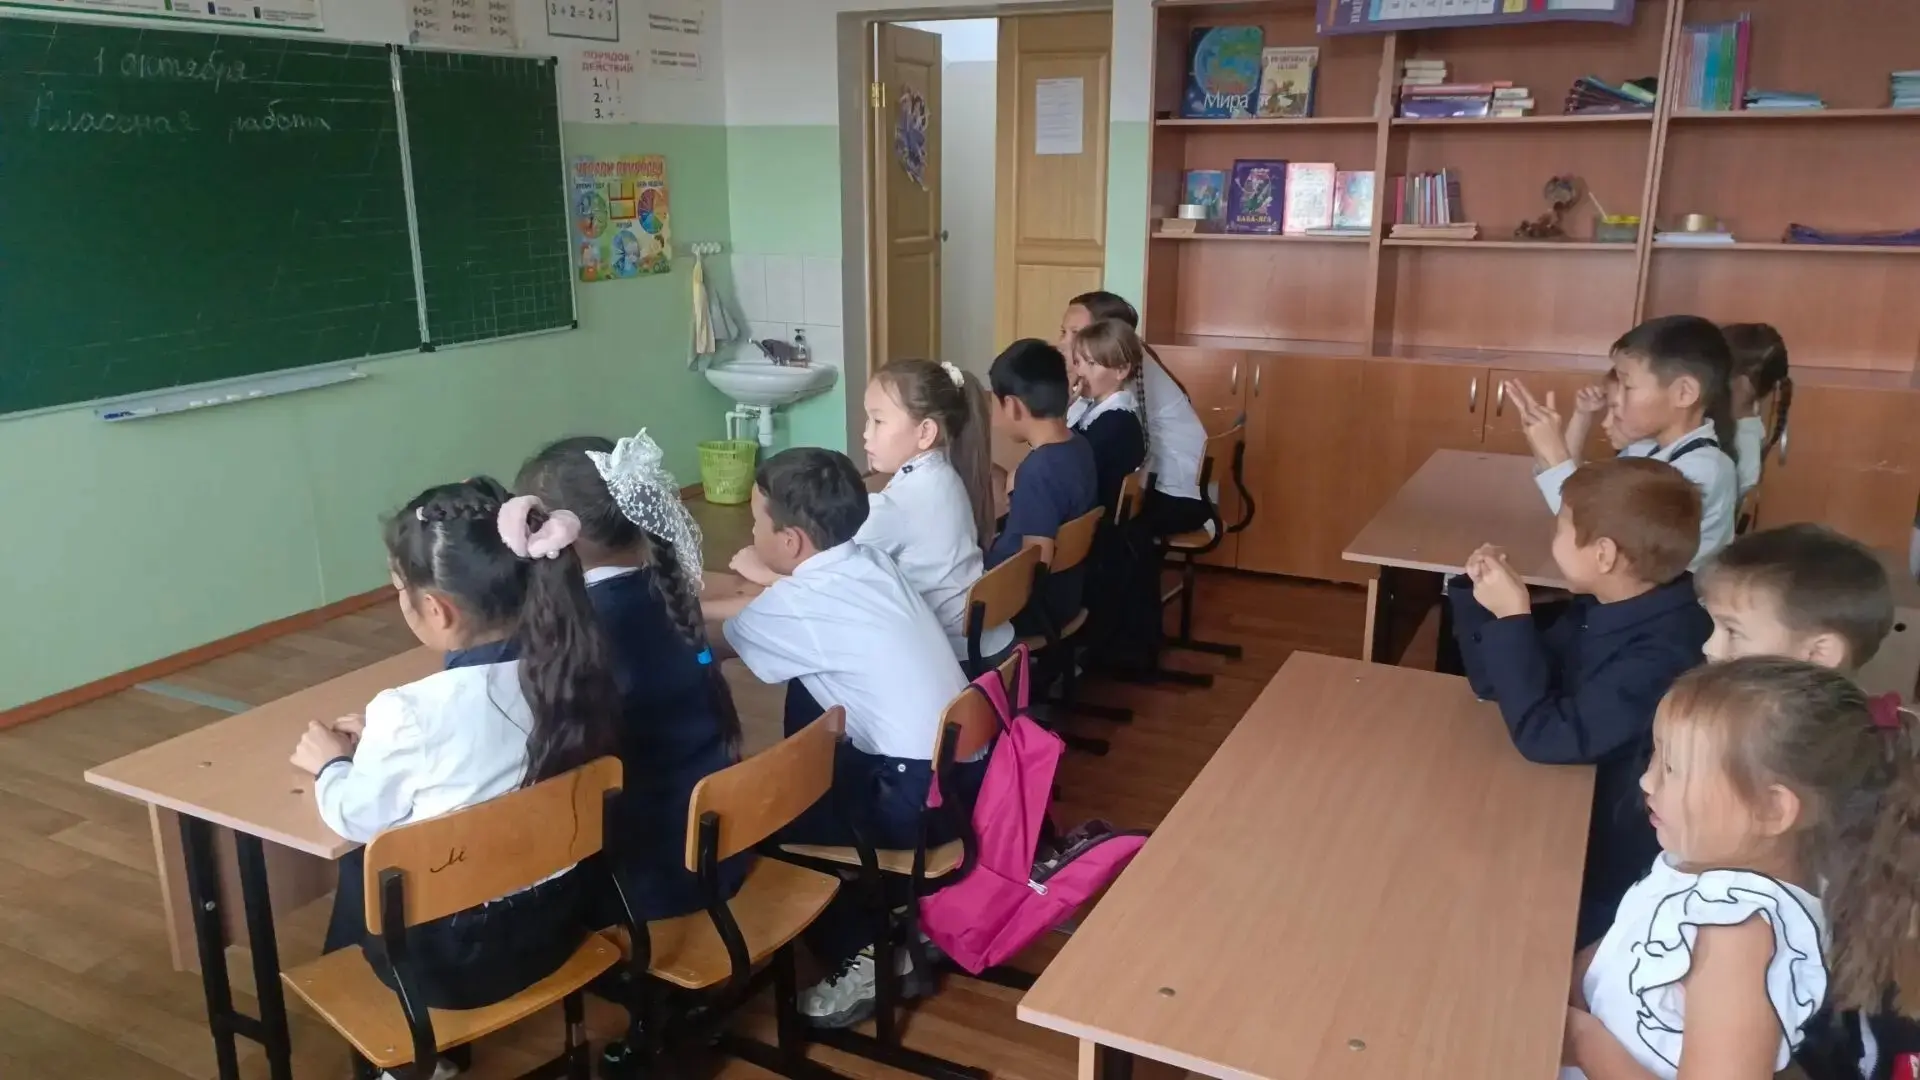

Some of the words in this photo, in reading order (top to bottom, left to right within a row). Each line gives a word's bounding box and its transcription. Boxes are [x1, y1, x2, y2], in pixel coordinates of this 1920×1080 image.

[550, 3, 557, 15] 3
[570, 5, 576, 18] 2
[588, 7, 594, 20] 2
[606, 10, 612, 22] 3
[592, 77, 602, 88] 1.
[593, 93, 603, 104] 2.
[1204, 91, 1249, 112] Мира
[594, 108, 604, 119] 3.
